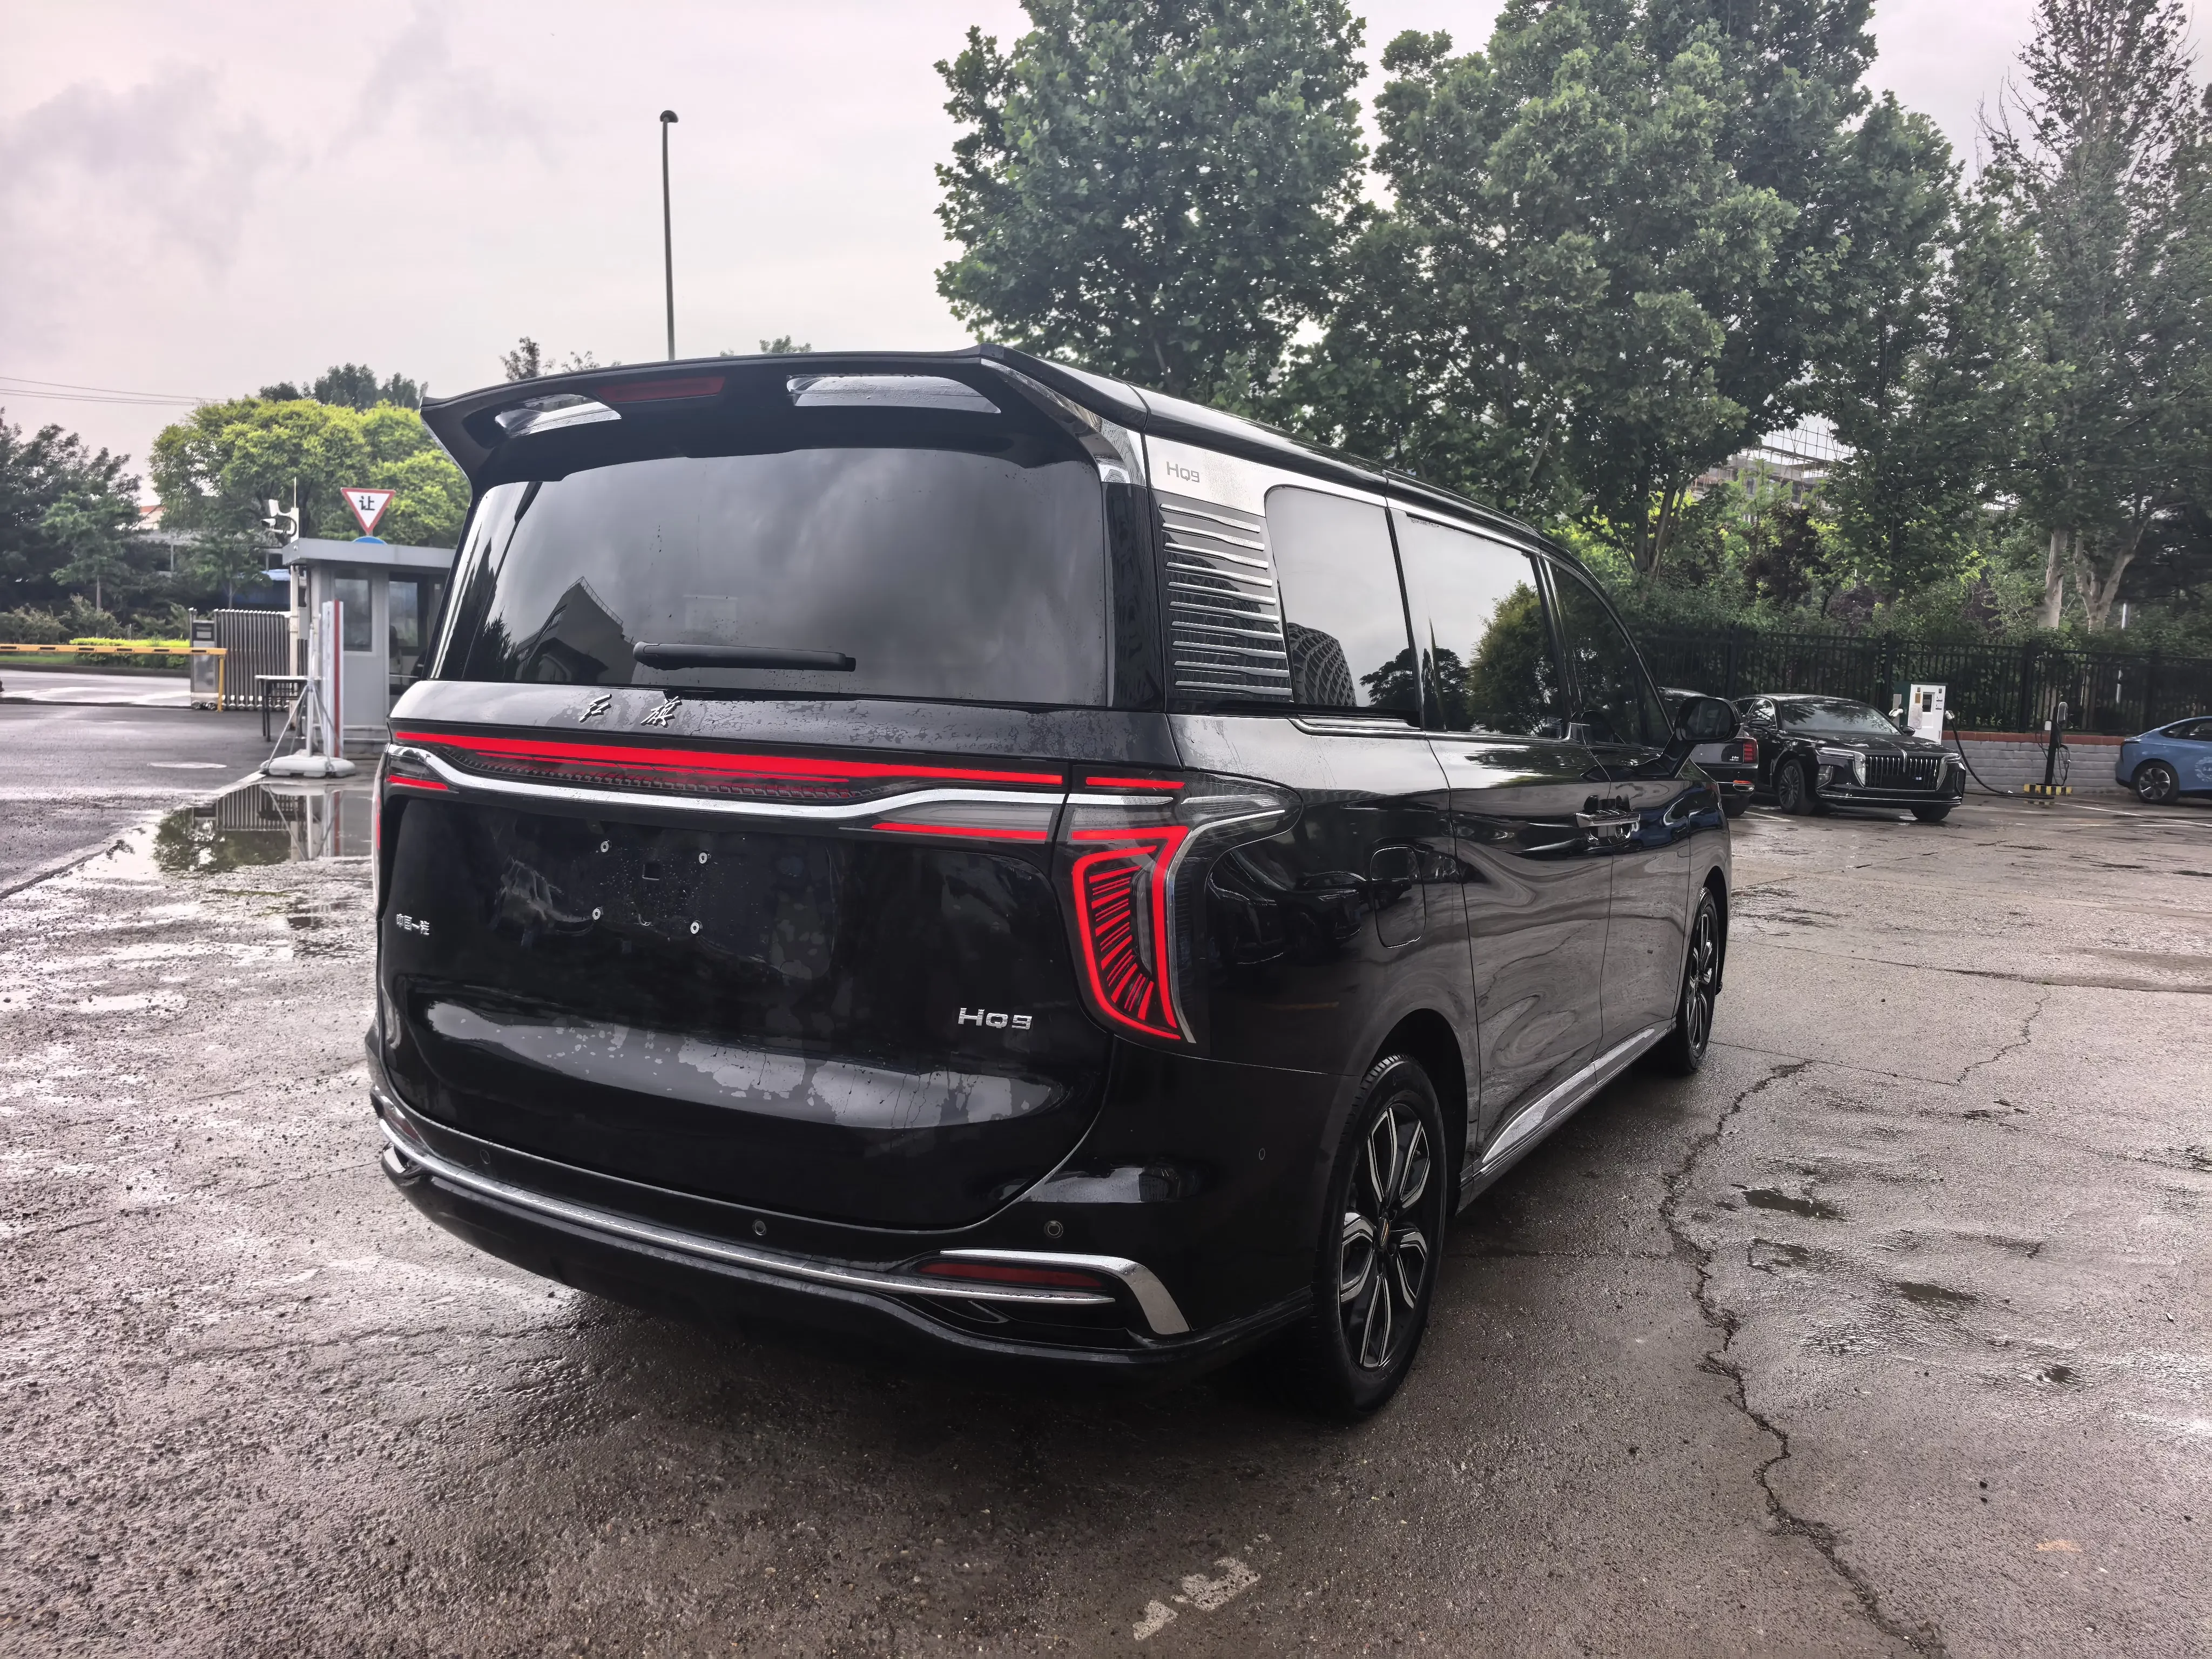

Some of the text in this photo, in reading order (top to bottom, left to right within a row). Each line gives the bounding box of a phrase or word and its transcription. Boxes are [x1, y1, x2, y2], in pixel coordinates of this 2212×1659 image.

[1166, 461, 1200, 483] HQ9
[359, 496, 375, 511] 让
[579, 693, 682, 728] 红旗
[957, 1007, 1033, 1030] HQ9
